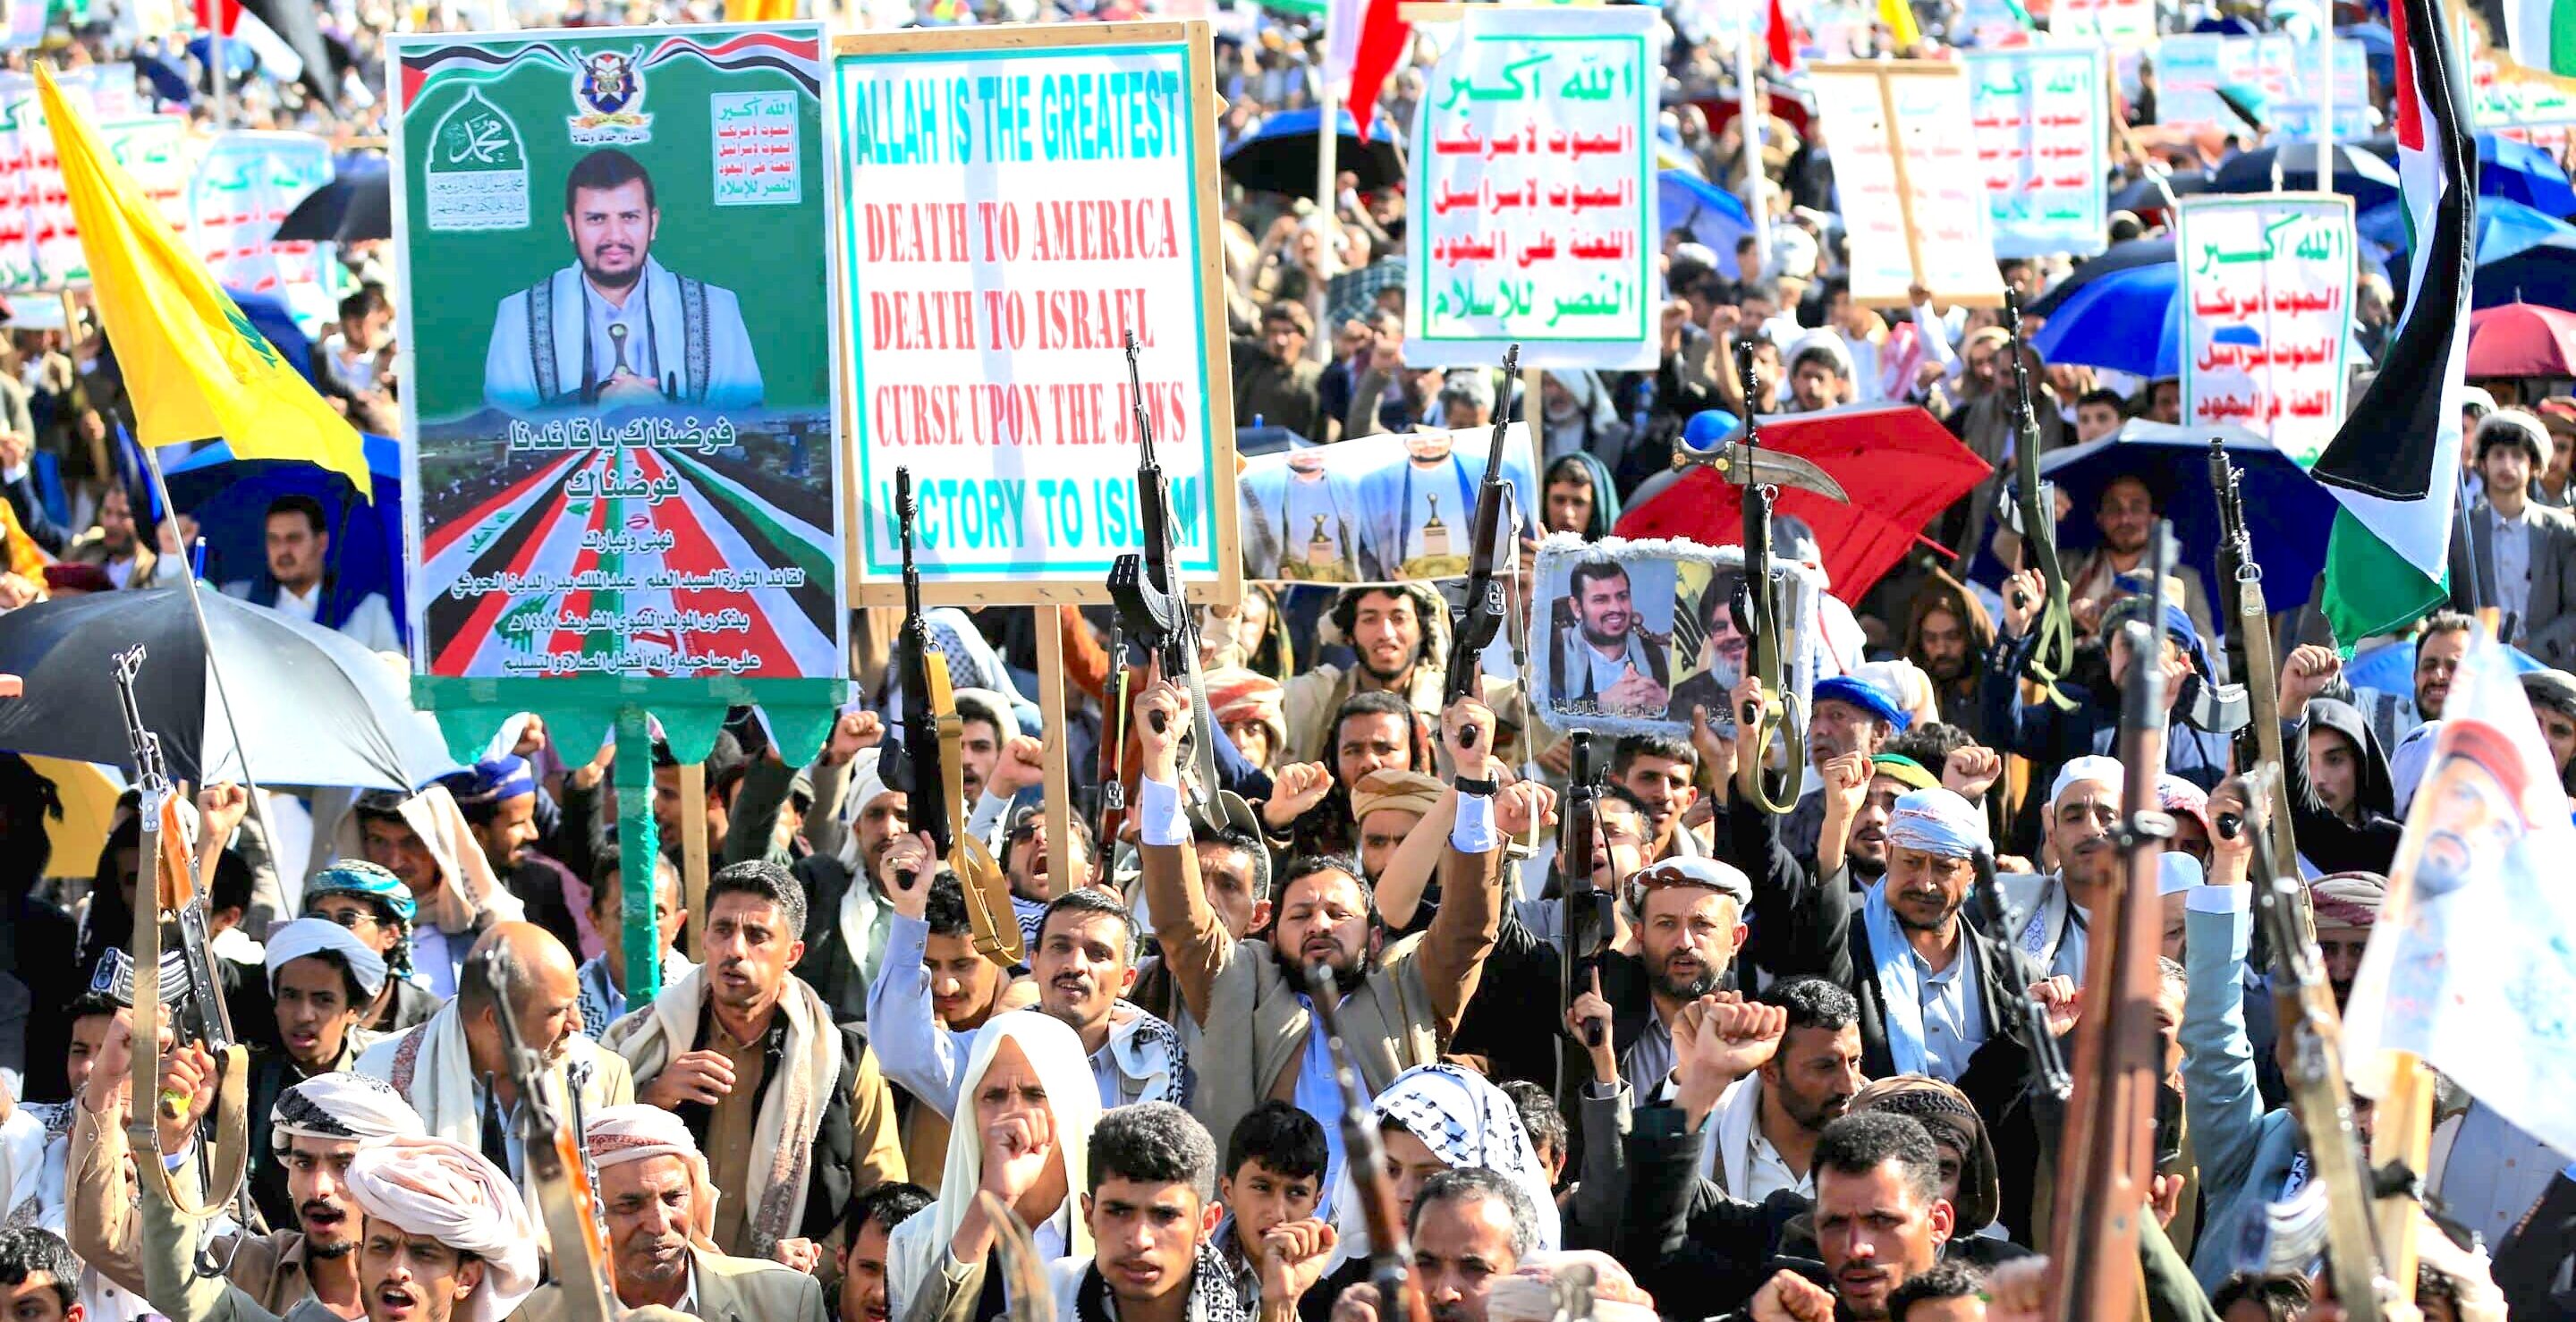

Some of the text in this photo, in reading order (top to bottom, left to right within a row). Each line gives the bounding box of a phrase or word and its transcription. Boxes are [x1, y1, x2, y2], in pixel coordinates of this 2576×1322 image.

[1436, 47, 1633, 117] الله أكبر
[717, 97, 792, 120] الله أكبر
[856, 71, 1178, 165] ALLAH IS THE GREATEST
[1435, 117, 1633, 162] الموت لأمريكا
[1548, 177, 1633, 215] الموت
[865, 197, 1179, 262] DEATH TO AMERICA
[1434, 228, 1633, 267] اللعنة على اليهود
[2196, 208, 2343, 281] الله أكبر
[1434, 273, 1633, 331] النصر للإسلام
[2274, 286, 2340, 318] الموت
[871, 288, 1155, 350] DEATH TO ISRAEL
[2274, 337, 2334, 371] الموت
[876, 383, 964, 447] CURSE
[969, 383, 1043, 445] UPON
[1049, 383, 1107, 445] THE
[619, 418, 735, 455] فوضناك
[565, 469, 680, 504] فوضناك
[881, 477, 1199, 550] VCTORY TO ISLM
[581, 530, 637, 554] ونبارك
[451, 571, 506, 599] الحوثي
[646, 569, 680, 594] العلم
[682, 569, 723, 591] السيد
[724, 568, 763, 591] الثورة
[767, 567, 805, 588] لقائد
[558, 610, 614, 634] الشريف
[614, 610, 660, 634] النبوي
[663, 609, 699, 631] المولد
[699, 608, 750, 633] بذكرى
[503, 652, 564, 677] والتسليم
[564, 651, 607, 673] الصلاة
[607, 648, 648, 674] أفضل
[679, 649, 730, 671] صاحبه
[732, 649, 762, 674] على
